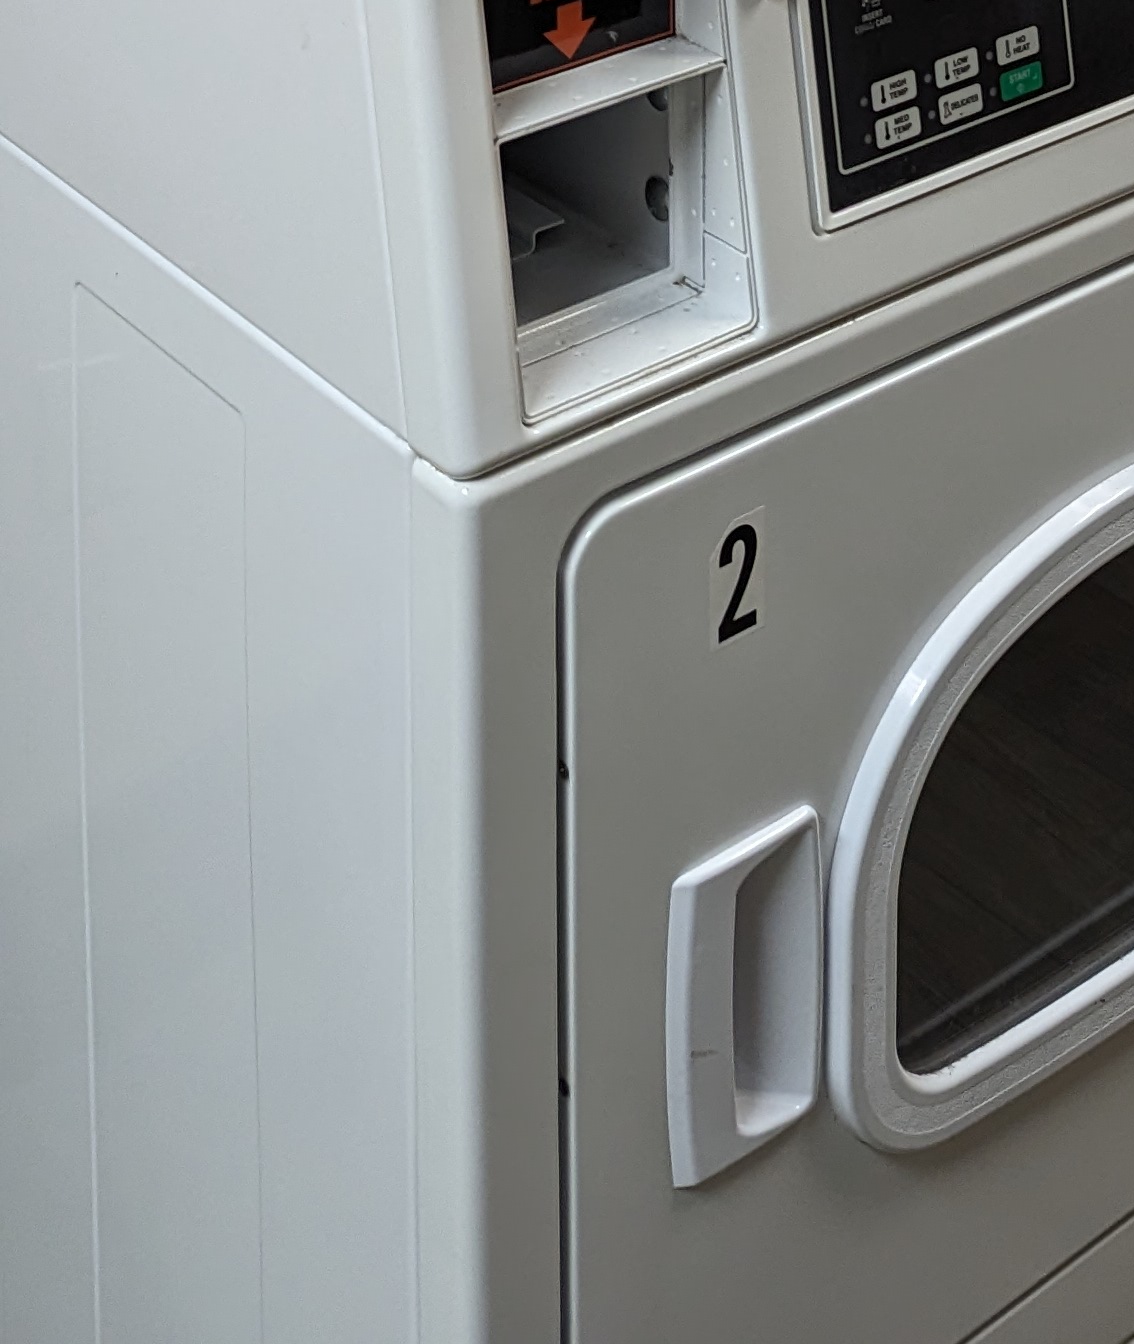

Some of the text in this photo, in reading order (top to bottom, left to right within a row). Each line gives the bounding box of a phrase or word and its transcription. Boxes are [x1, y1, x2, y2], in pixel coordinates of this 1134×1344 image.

[1015, 35, 1026, 44] NO
[1013, 42, 1030, 55] HEAT
[952, 56, 968, 67] LOW
[953, 64, 971, 76] TEMP
[889, 78, 907, 90] HIGH
[889, 87, 908, 100] TEMP
[894, 114, 910, 125] MED
[894, 122, 912, 135] TEMP
[718, 524, 757, 644] 2
